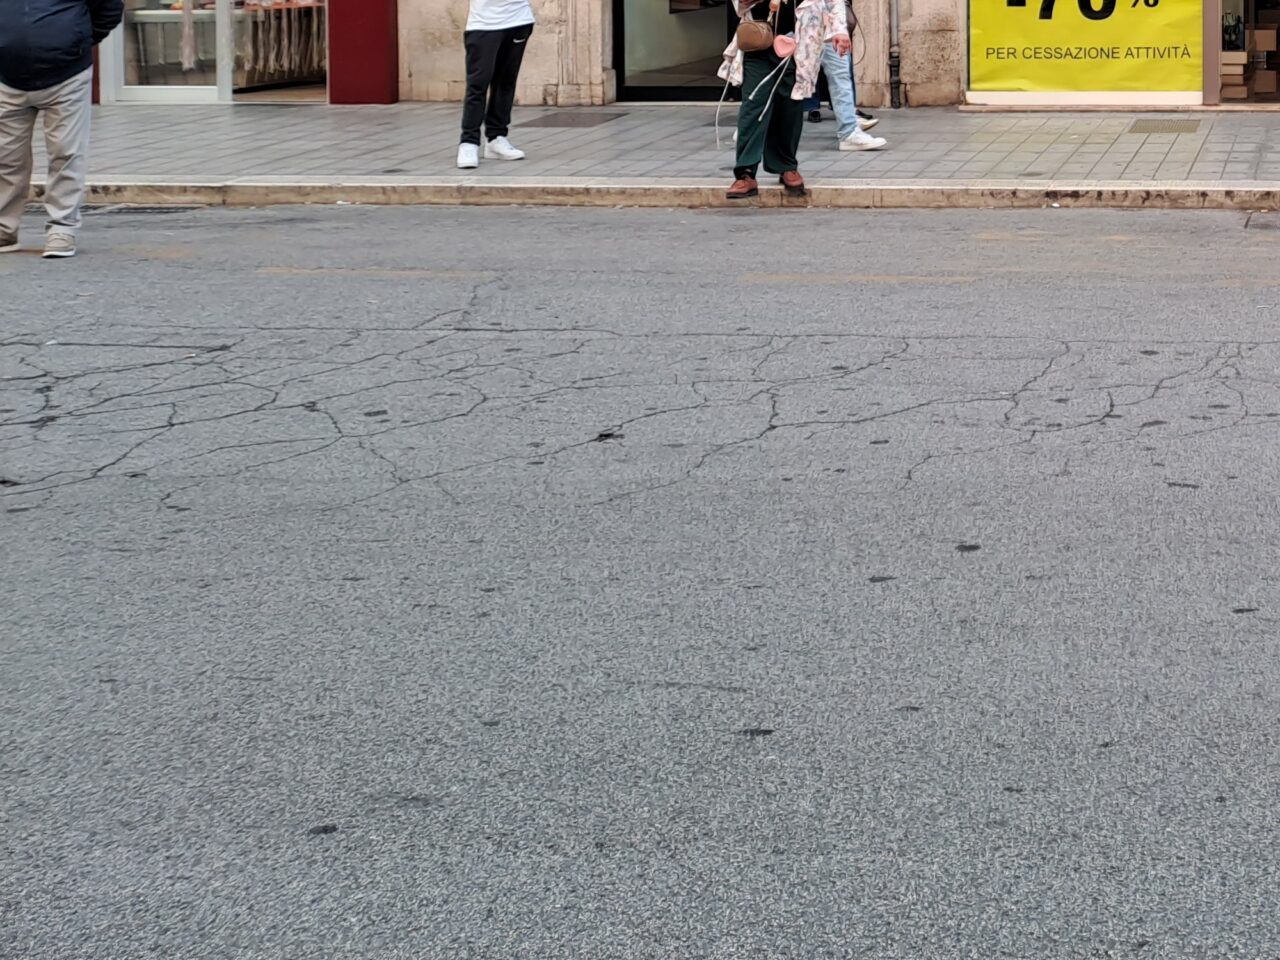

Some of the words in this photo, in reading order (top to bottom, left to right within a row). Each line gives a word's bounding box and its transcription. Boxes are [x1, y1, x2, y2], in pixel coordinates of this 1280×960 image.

[986, 47, 1017, 60] PER
[1022, 46, 1120, 60] CESSAZIONE
[1125, 43, 1191, 59] ATTIVITÀ
